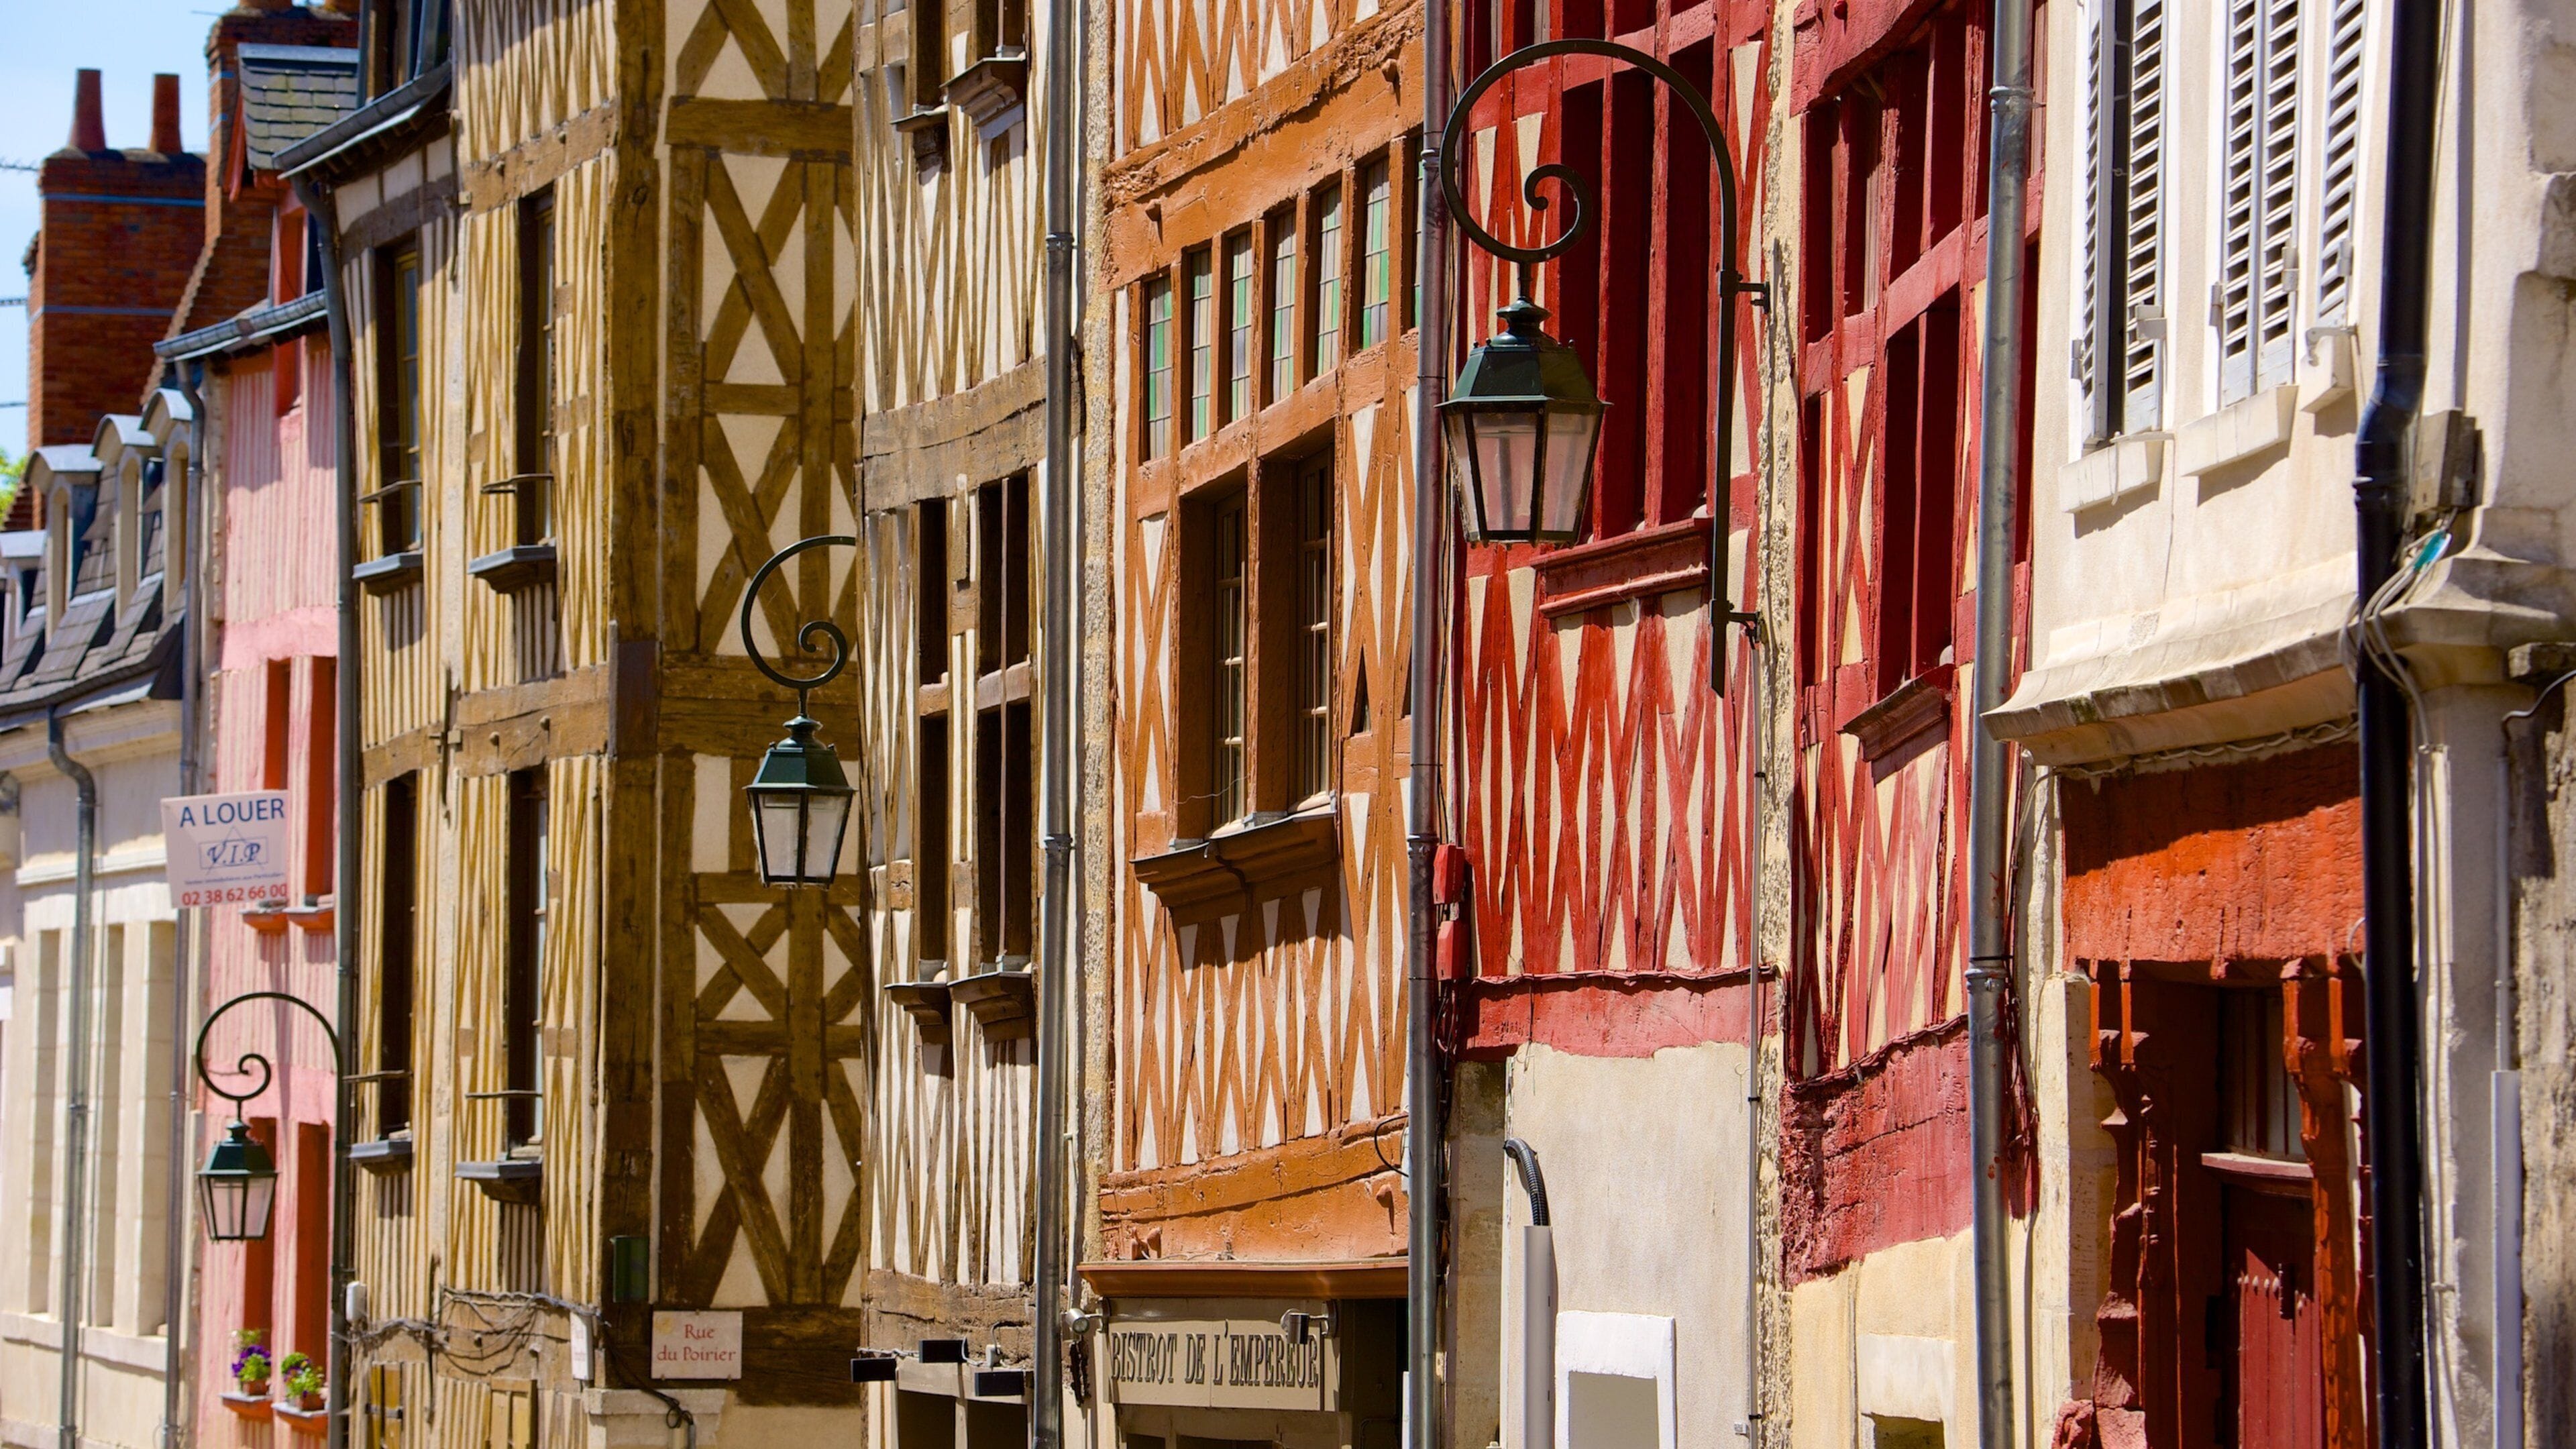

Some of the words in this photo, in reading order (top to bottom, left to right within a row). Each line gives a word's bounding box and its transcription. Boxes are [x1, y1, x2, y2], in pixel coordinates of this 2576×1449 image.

[180, 806, 196, 828] A
[203, 798, 284, 825] LOUER
[182, 892, 200, 905] 02
[205, 890, 222, 904] 38
[226, 888, 244, 901] 62
[248, 886, 266, 899] 66
[270, 883, 287, 897] 00
[684, 1324, 715, 1340] Rue
[656, 1345, 678, 1361] du
[683, 1346, 737, 1361] Poirier
[1111, 1332, 1177, 1384] BISTROT
[1185, 1334, 1205, 1385] DE
[1213, 1319, 1320, 1388] L'EMPEREUR
